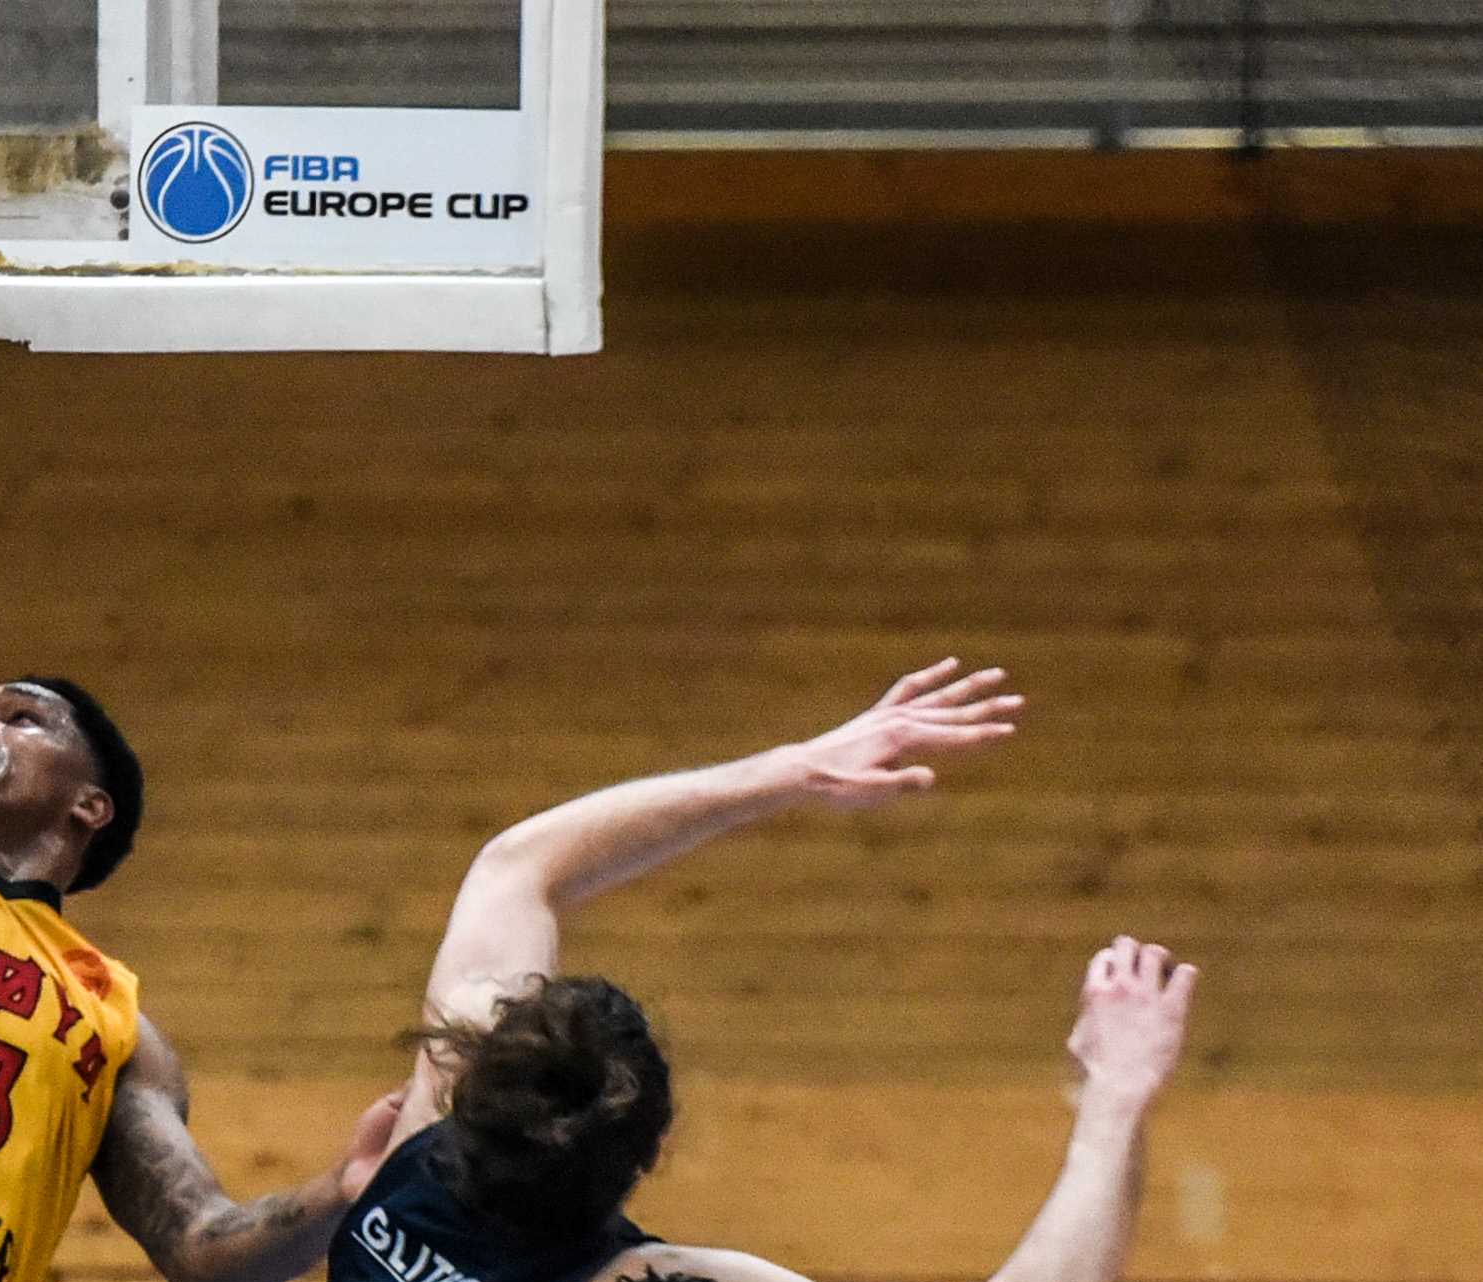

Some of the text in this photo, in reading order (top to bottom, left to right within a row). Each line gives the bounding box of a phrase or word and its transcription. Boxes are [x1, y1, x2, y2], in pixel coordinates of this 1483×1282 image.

[264, 155, 359, 181] FIBA
[264, 190, 529, 219] EUROPE CUP
